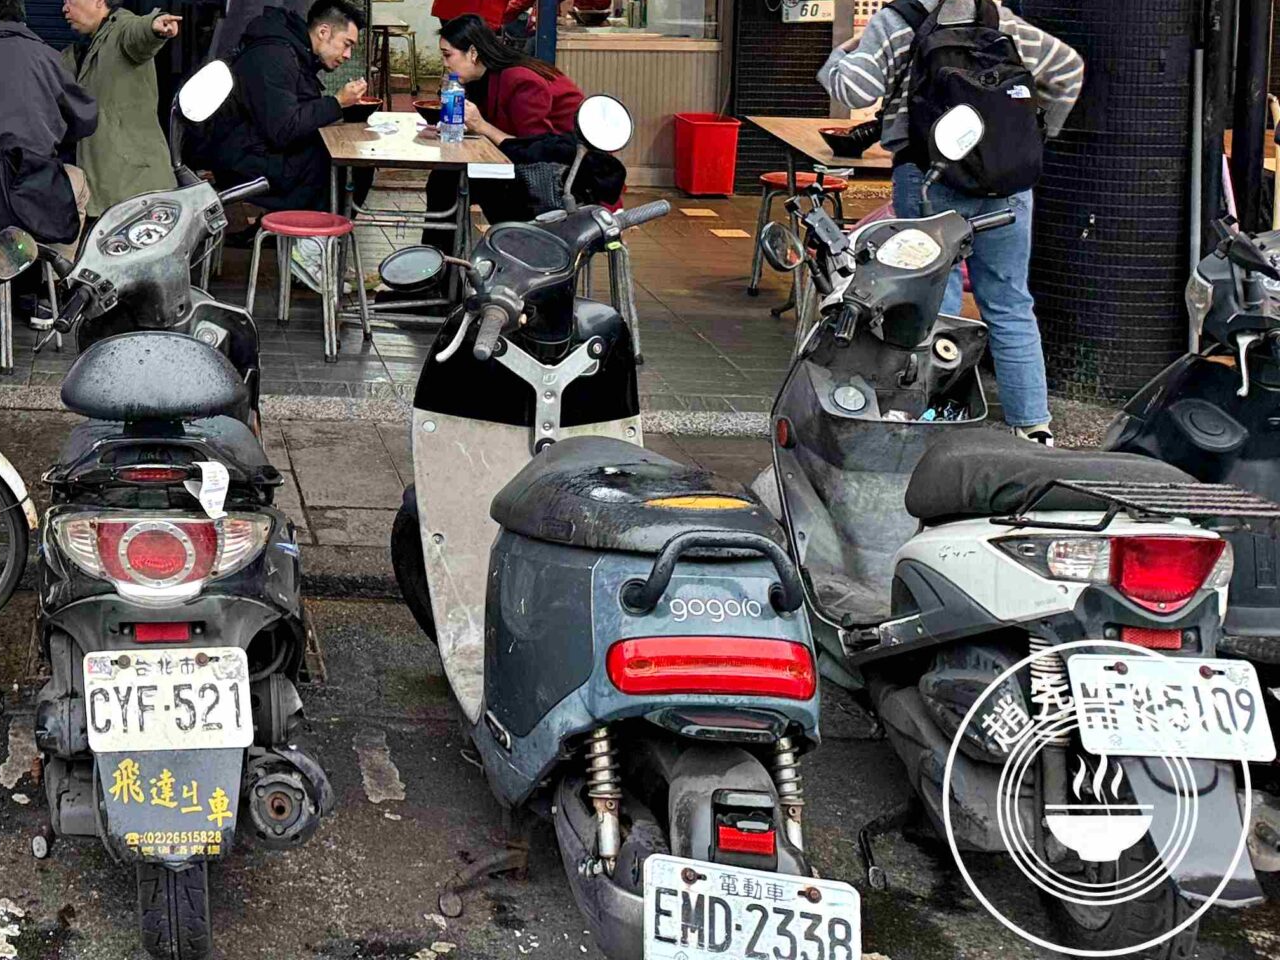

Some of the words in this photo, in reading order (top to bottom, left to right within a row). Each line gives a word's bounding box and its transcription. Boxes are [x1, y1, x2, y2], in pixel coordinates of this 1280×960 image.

[800, 3, 819, 17] 60
[669, 598, 762, 623] gogoro
[135, 656, 195, 676] 台北市
[89, 682, 241, 734] CYF-521
[719, 872, 786, 903] 電動車
[654, 886, 852, 960] EMD-2338
